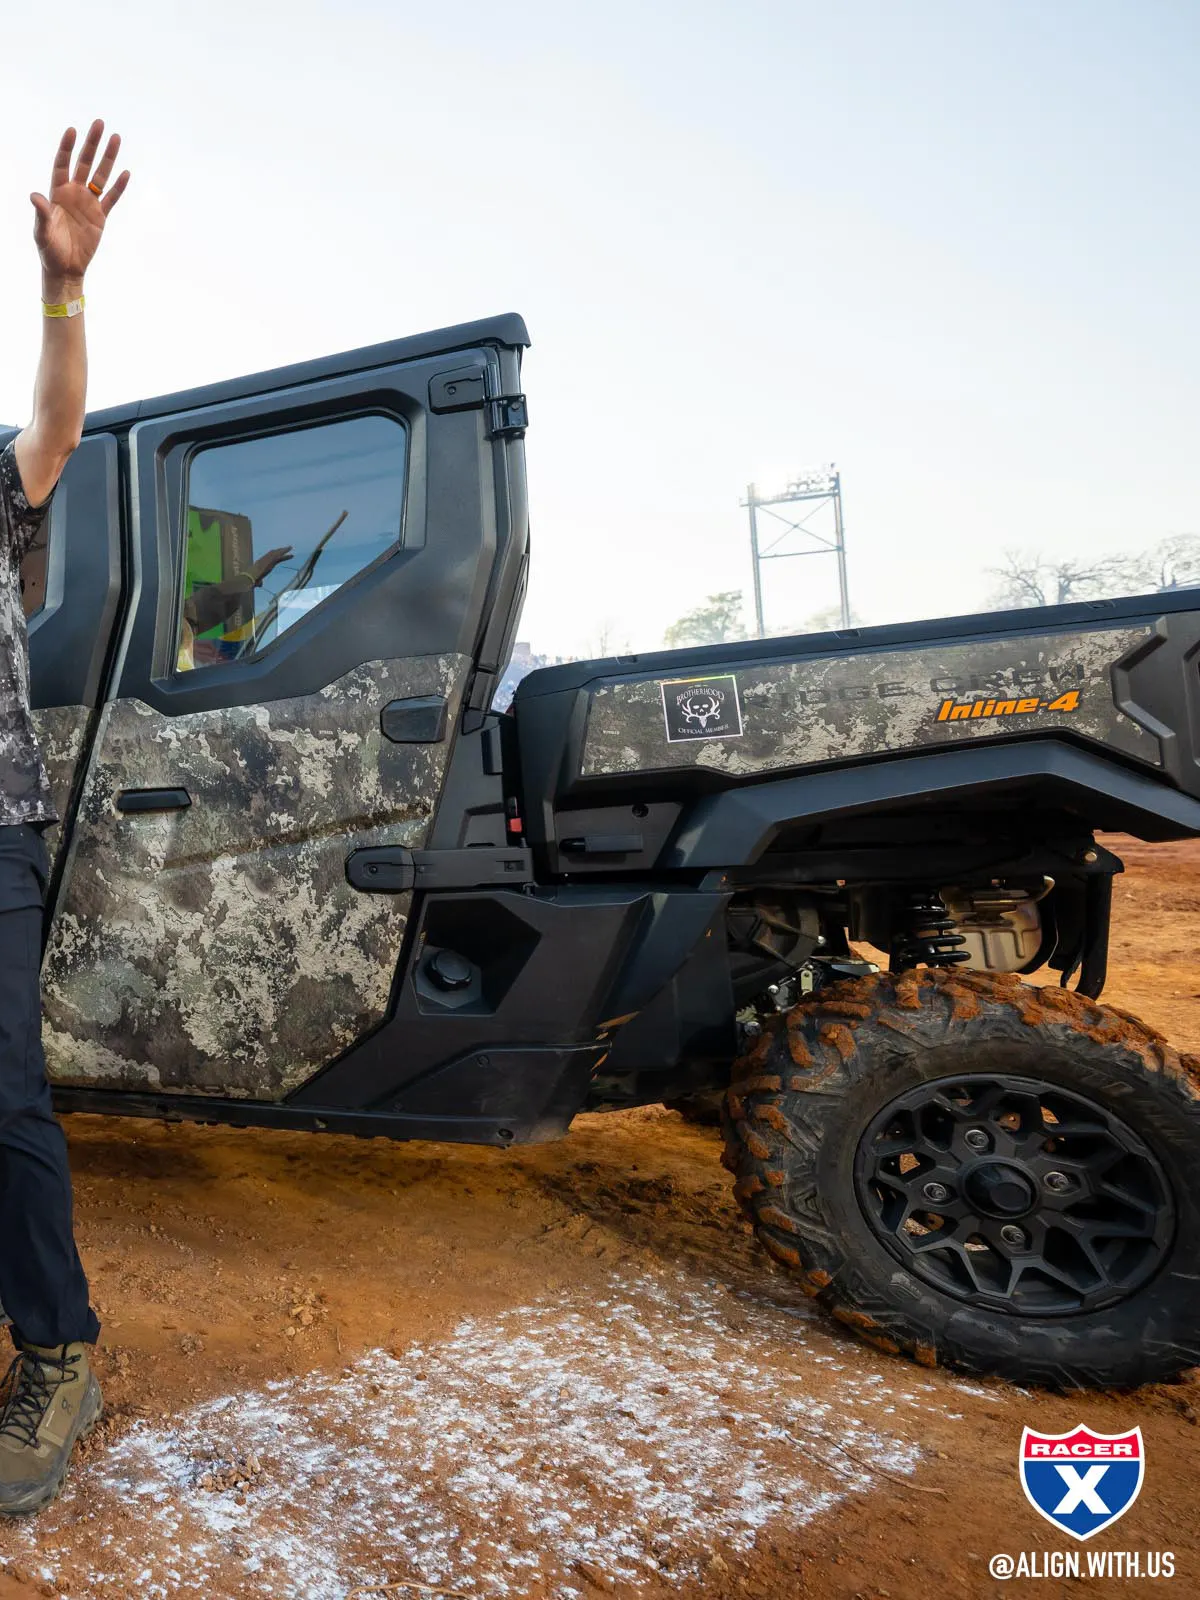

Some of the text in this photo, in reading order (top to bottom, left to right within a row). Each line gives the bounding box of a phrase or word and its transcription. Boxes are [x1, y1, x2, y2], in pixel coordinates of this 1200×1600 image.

[676, 687, 725, 705] BROTHERHOOD
[937, 690, 1081, 721] Inline-4
[705, 723, 729, 734] MEMBER
